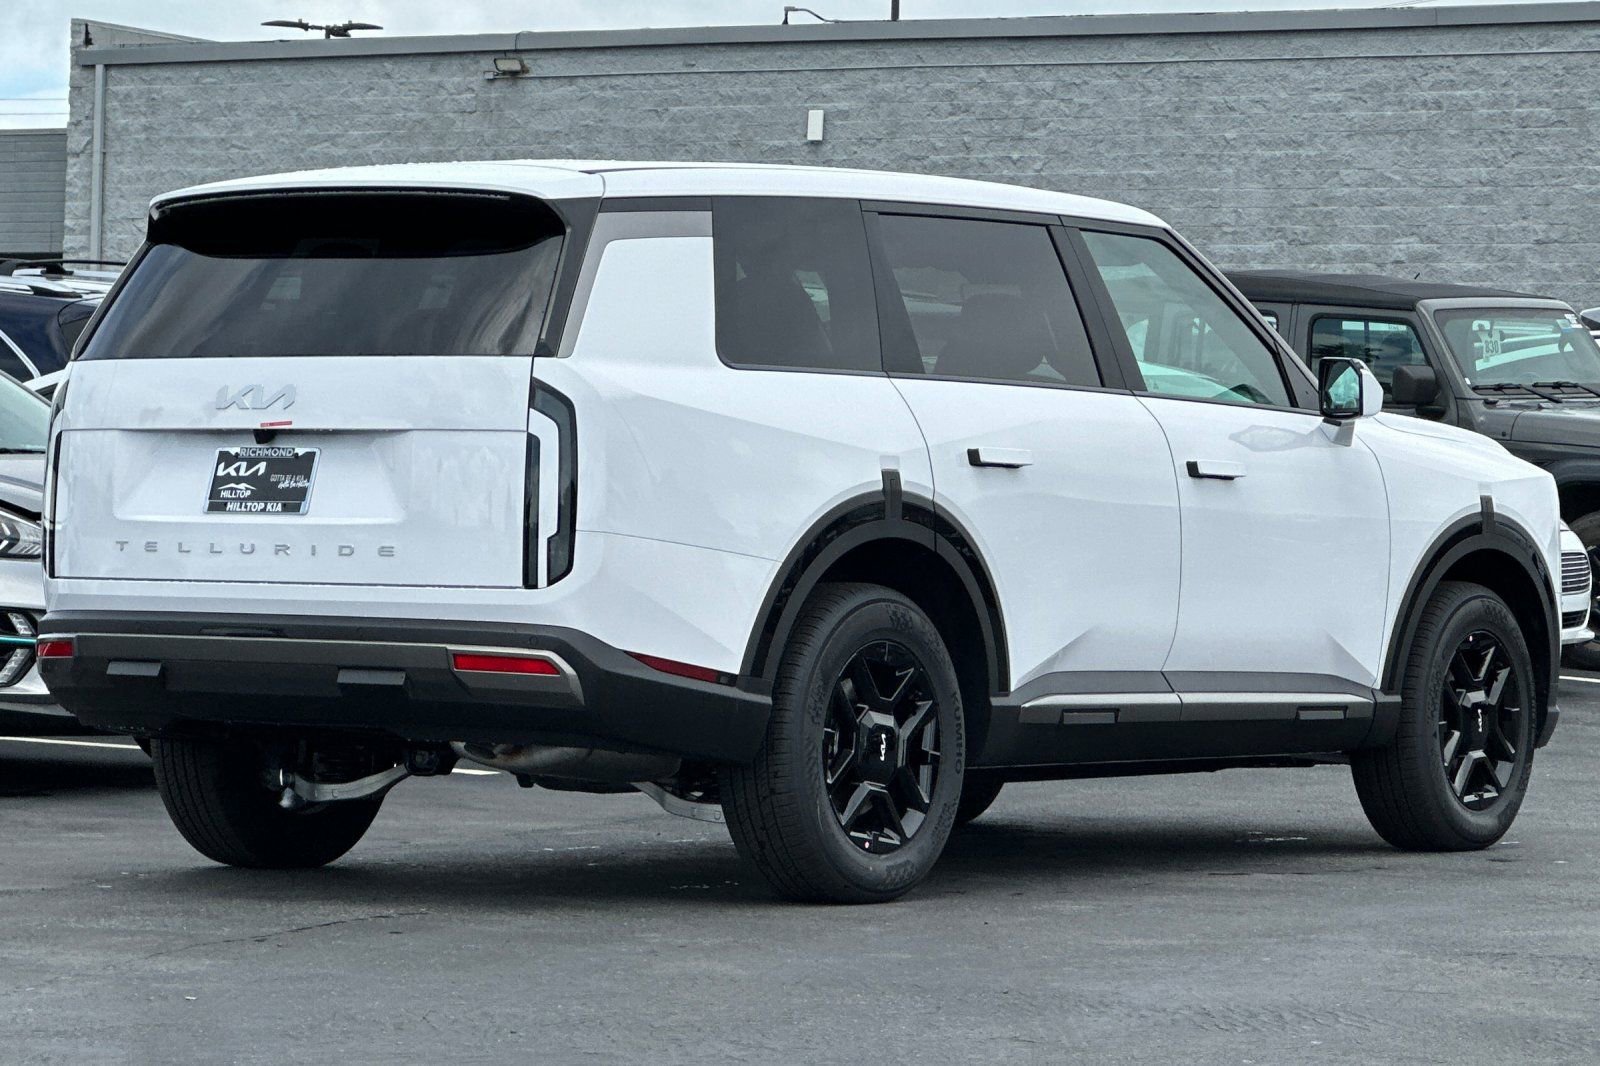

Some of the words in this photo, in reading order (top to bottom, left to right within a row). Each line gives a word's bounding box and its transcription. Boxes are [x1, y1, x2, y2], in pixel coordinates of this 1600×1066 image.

[215, 384, 297, 410] KIA
[240, 448, 294, 457] RICHMOND
[216, 461, 267, 476] KIA
[220, 489, 251, 498] HILLTOP
[226, 502, 265, 511] HILLTOP
[266, 502, 282, 512] KIA
[115, 541, 395, 557] TELLURIDE
